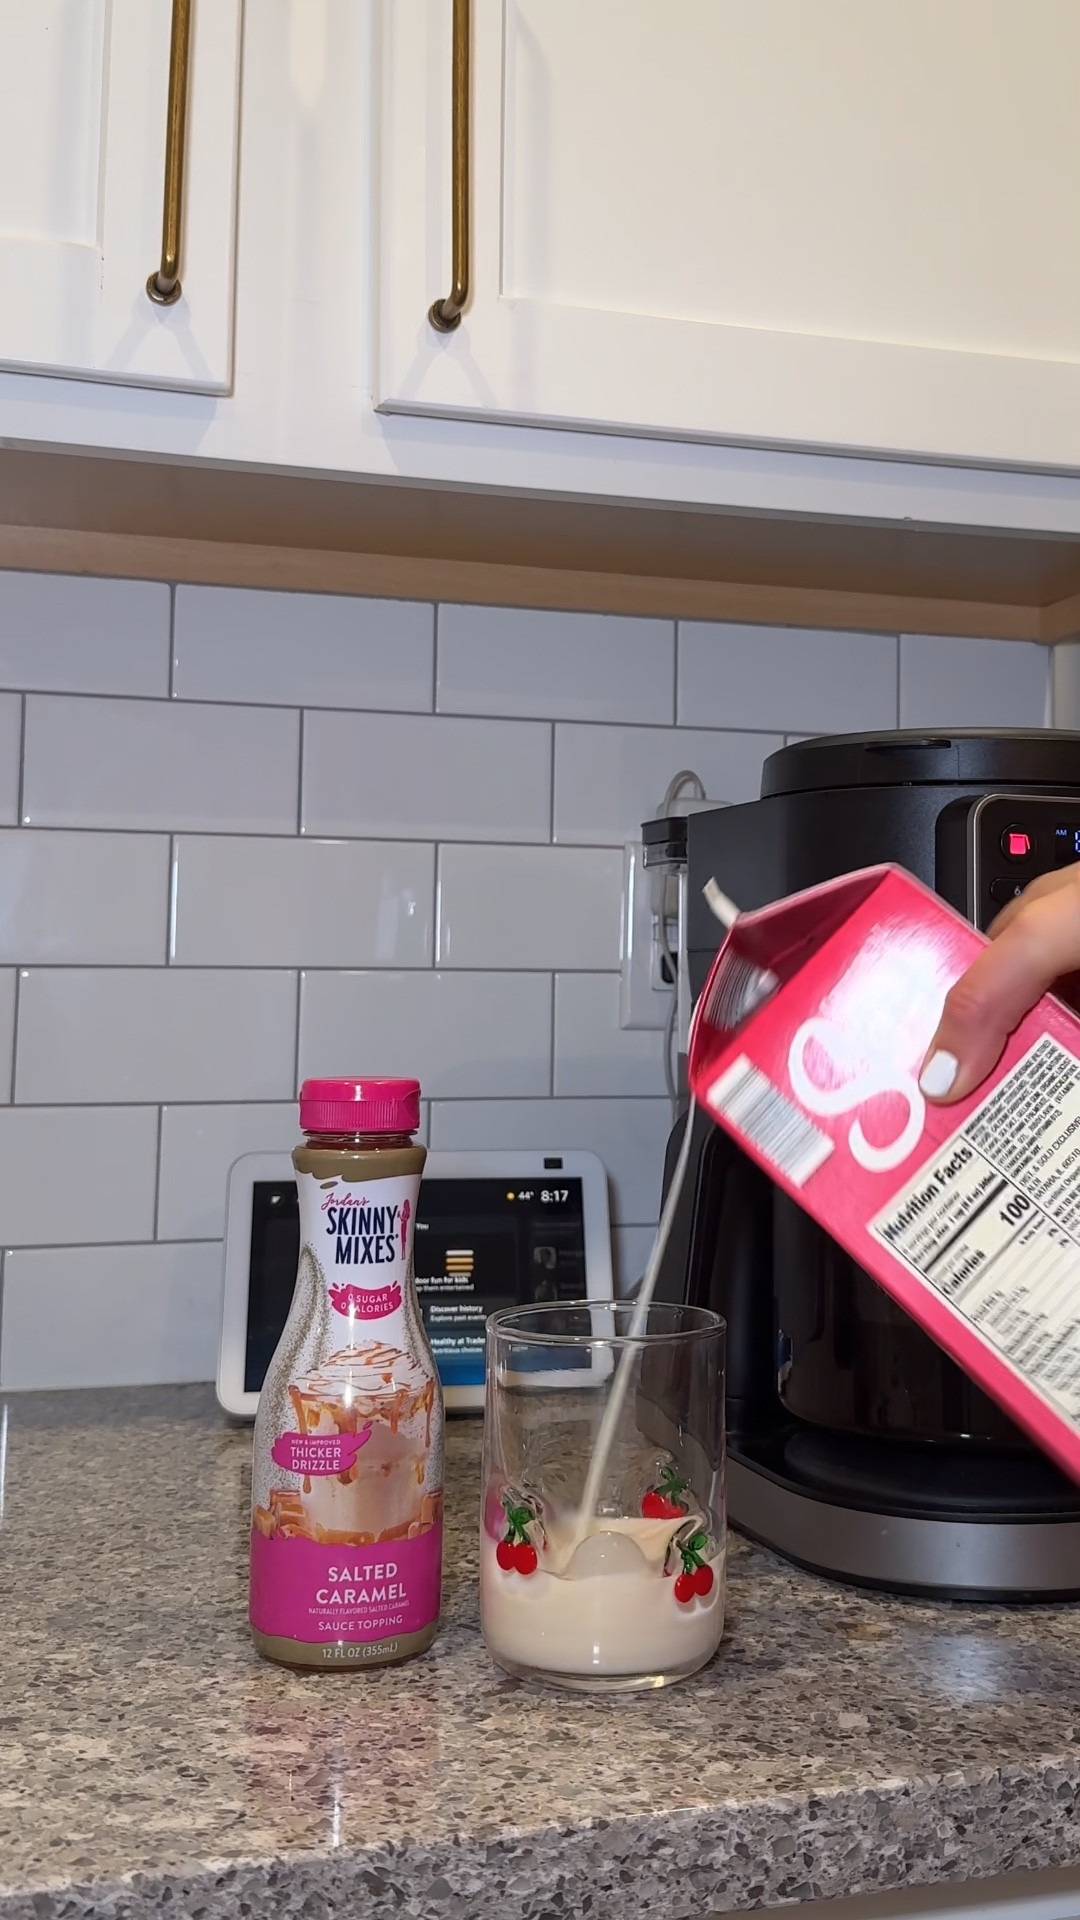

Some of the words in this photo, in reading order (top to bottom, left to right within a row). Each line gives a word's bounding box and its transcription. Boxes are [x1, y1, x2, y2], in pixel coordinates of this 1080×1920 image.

[321, 1193, 370, 1210] Jordan's
[541, 1189, 569, 1202] 8:17
[882, 1184, 940, 1241] Nutrition
[933, 1147, 973, 1186] Facts
[326, 1205, 398, 1235] SKINNY
[335, 1234, 396, 1264] MIXES
[941, 1250, 986, 1295] Calories
[999, 1194, 1030, 1226] 100
[356, 1293, 388, 1303] SUGAR
[341, 1302, 346, 1310] 0
[349, 1302, 394, 1313] ALORIES
[291, 1447, 341, 1457] THICKER
[292, 1459, 340, 1470] DRIZZLE
[328, 1563, 398, 1582] SALTED
[316, 1582, 407, 1605] CARAMEL
[308, 1607, 339, 1615] NATURALLY
[340, 1605, 368, 1615] FLAVORED
[318, 1621, 355, 1631] SAUCE
[357, 1614, 403, 1630] TOPPING
[322, 1648, 332, 1658] 12
[335, 1648, 346, 1658] FL
[347, 1647, 360, 1658] OZ
[362, 1641, 398, 1658] (355mL)
